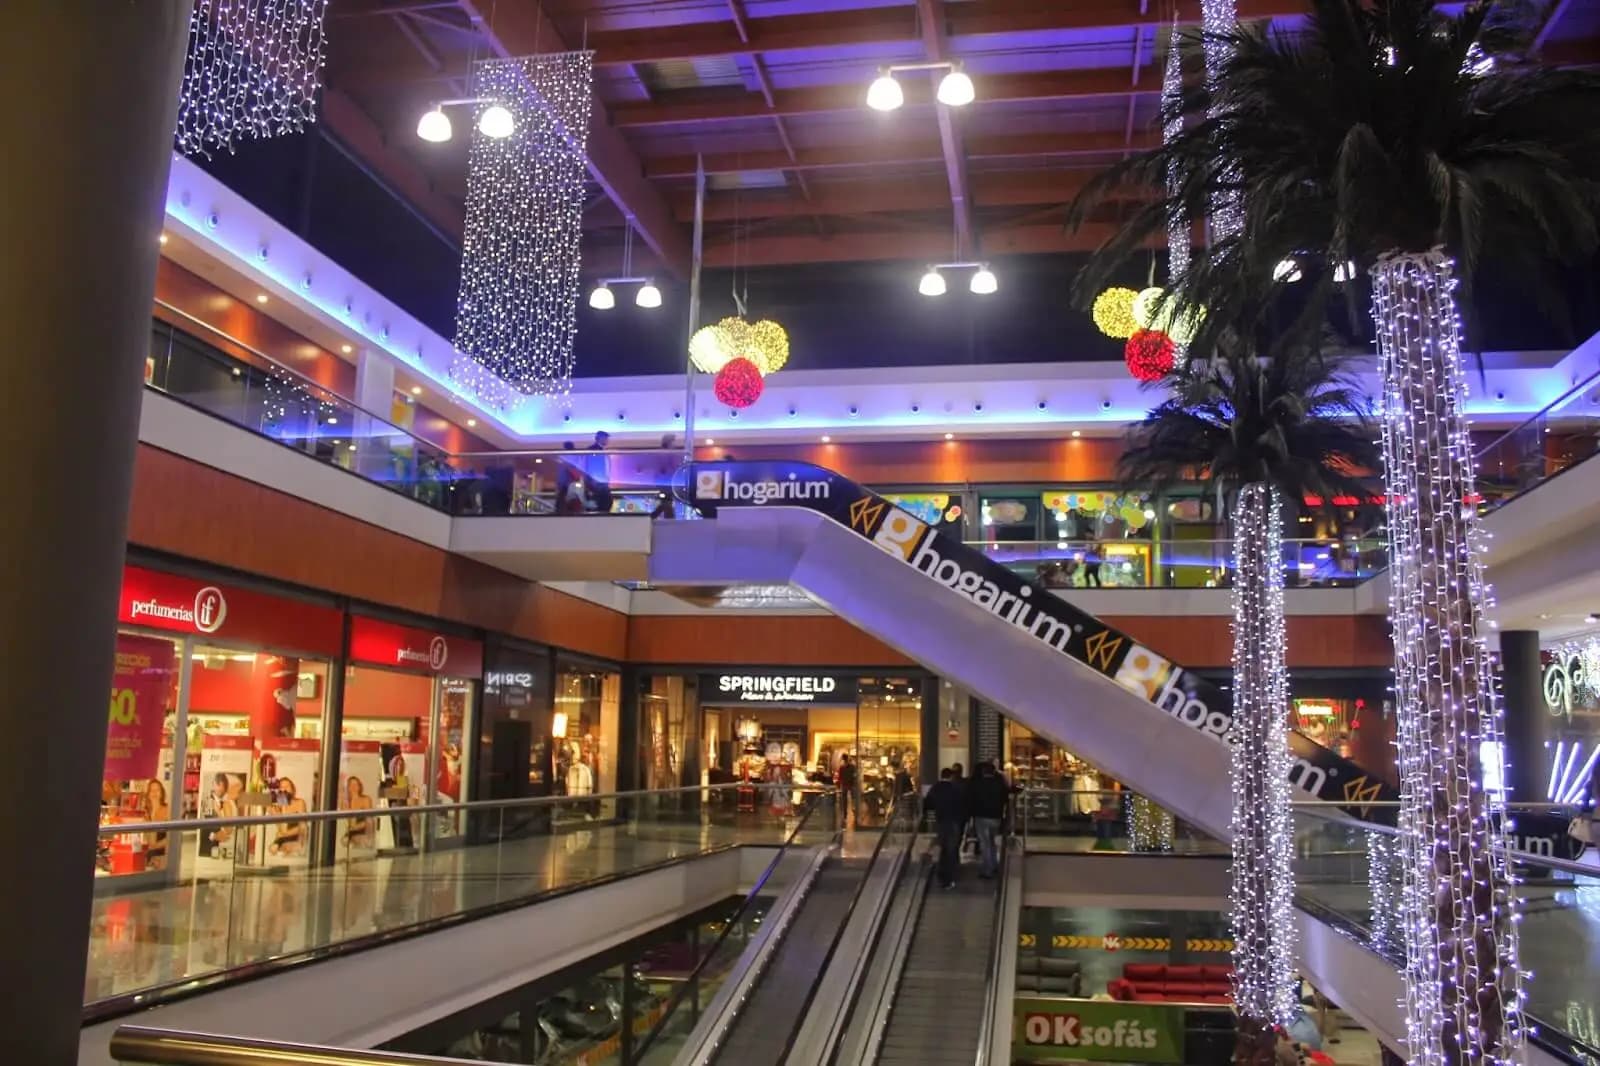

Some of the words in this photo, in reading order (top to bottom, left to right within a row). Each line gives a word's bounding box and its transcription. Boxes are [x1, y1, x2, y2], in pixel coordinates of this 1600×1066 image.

[724, 471, 829, 504] hogarium
[911, 528, 1073, 652] hogarium
[719, 676, 835, 692] SPRINGFIELD
[1026, 1015, 1157, 1048] OKsofás
